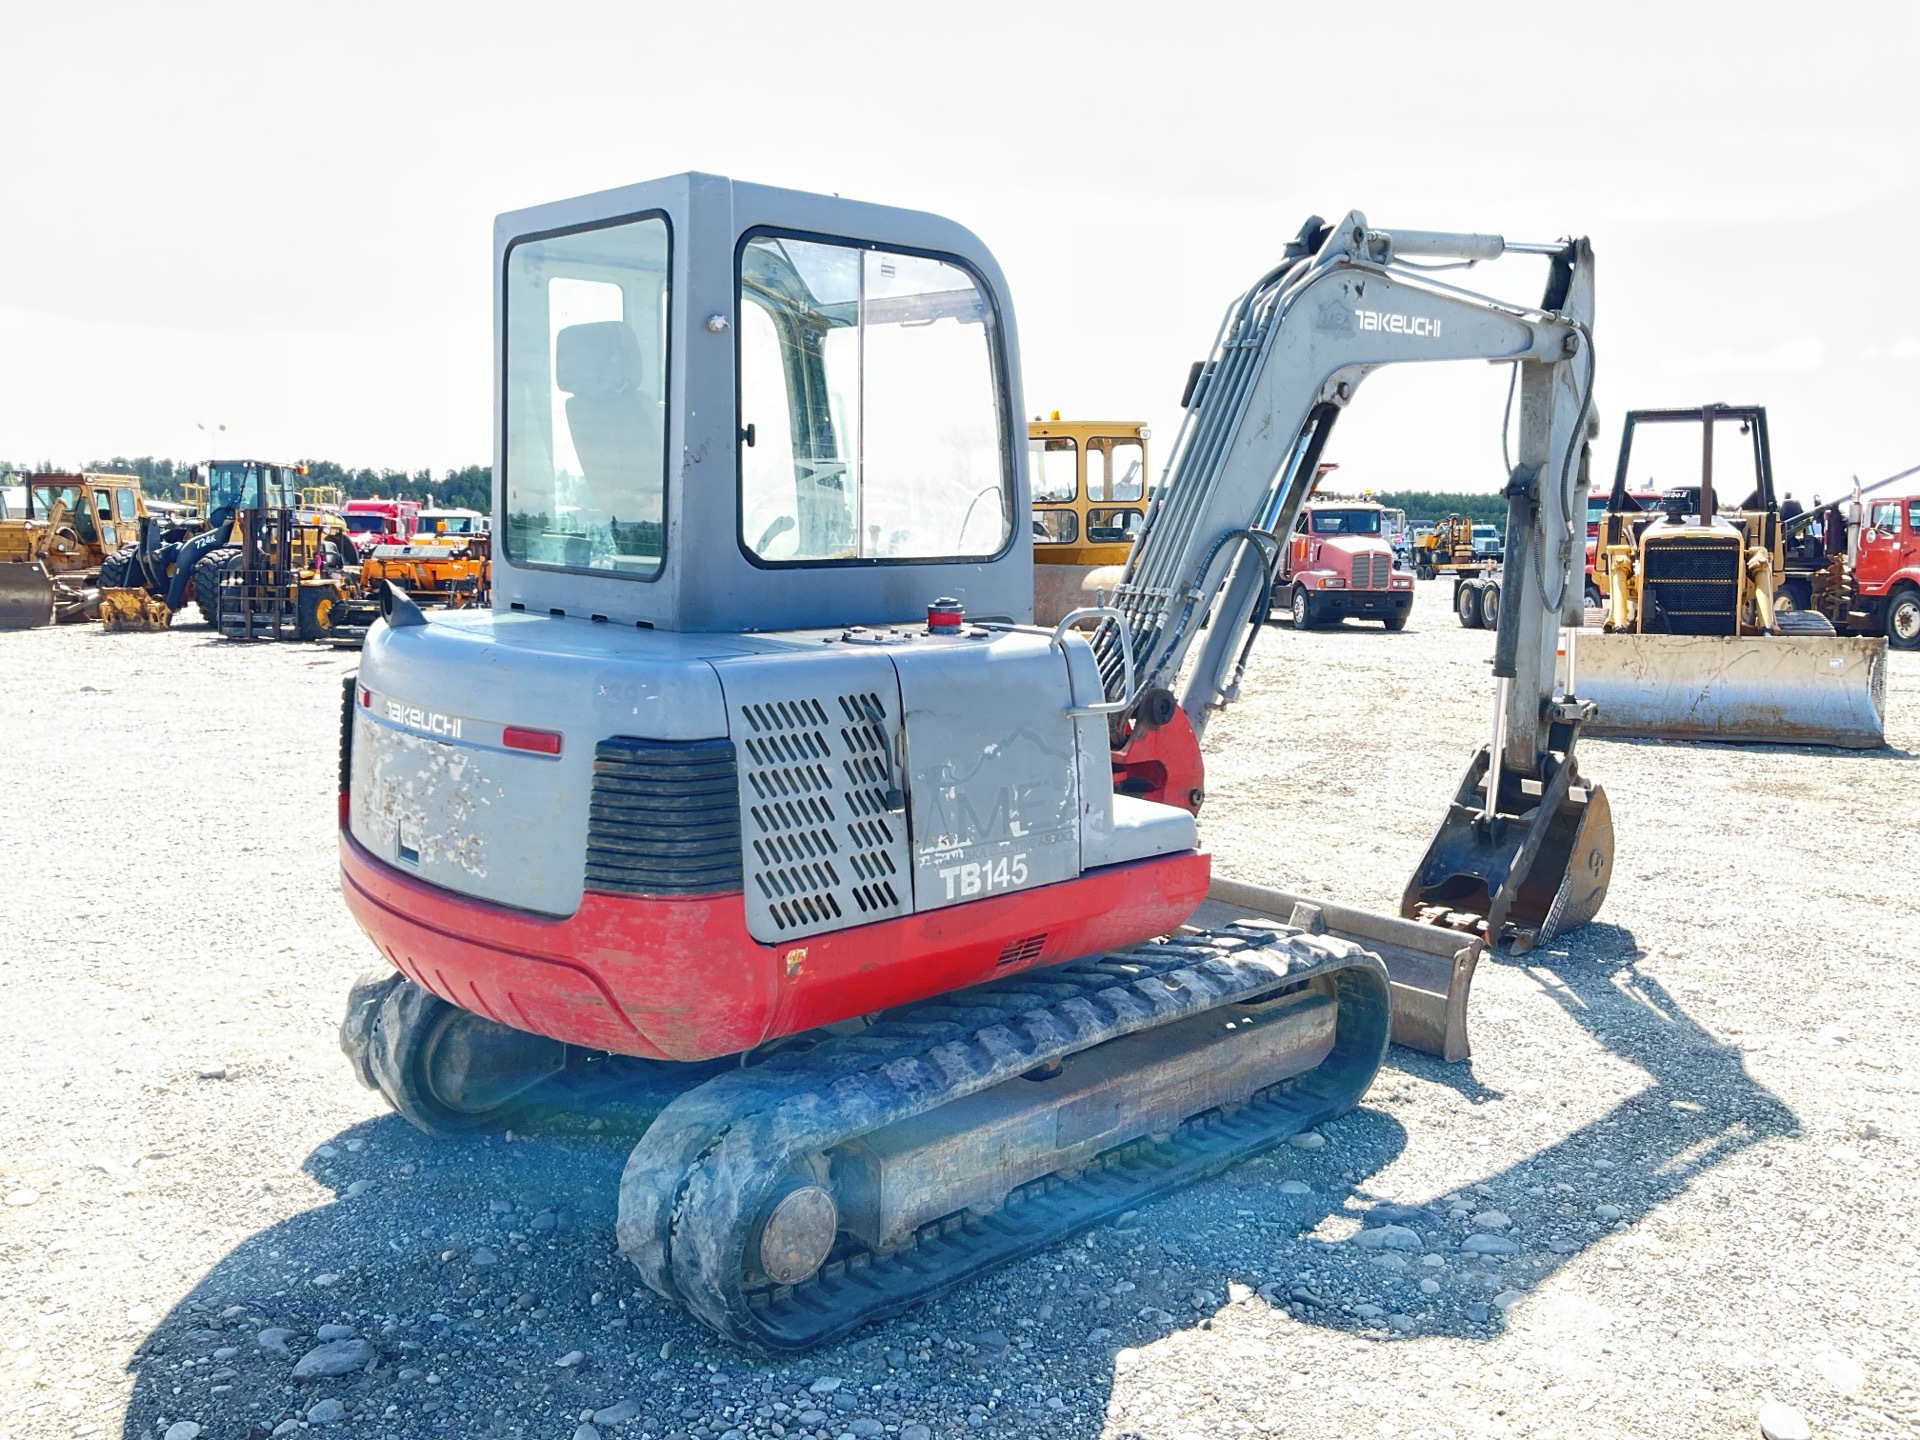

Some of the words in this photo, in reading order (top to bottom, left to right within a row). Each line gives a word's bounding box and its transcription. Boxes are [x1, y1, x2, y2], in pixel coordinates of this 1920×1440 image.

[1354, 309, 1441, 338] TAKEUCHI
[195, 535, 217, 549] 724K
[386, 701, 462, 738] TAKEUCHI
[939, 852, 1029, 900] TB145
